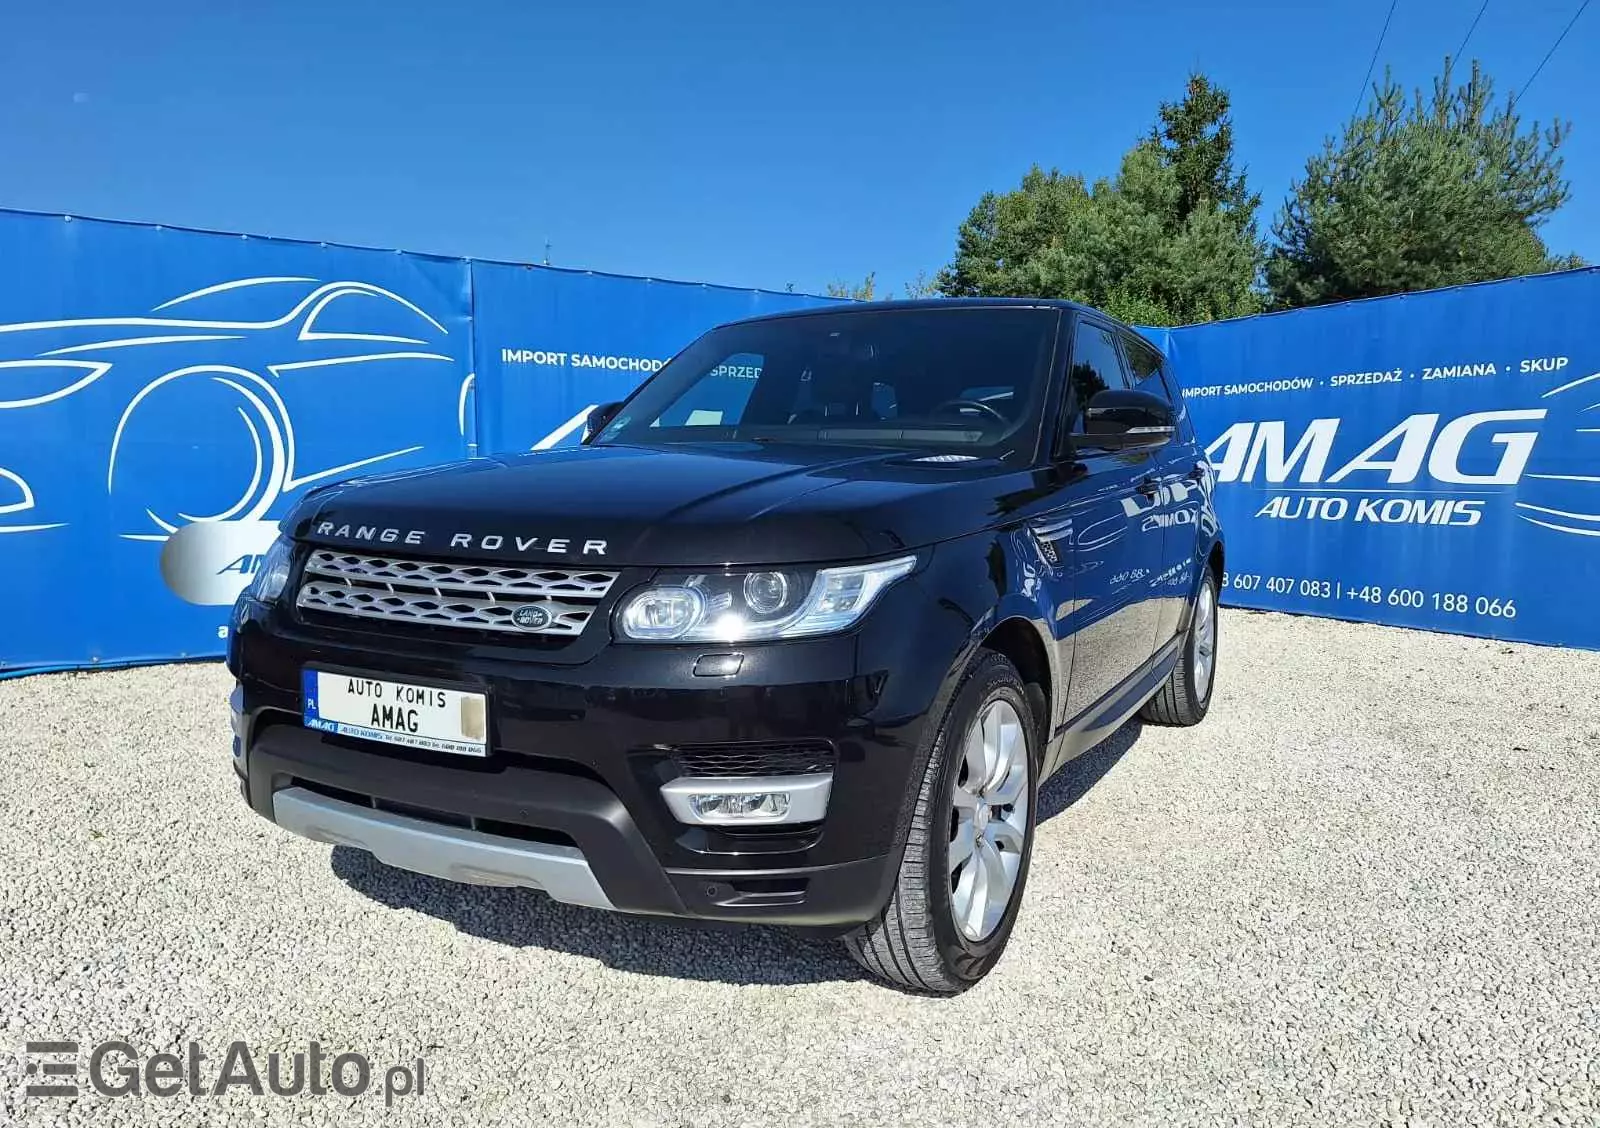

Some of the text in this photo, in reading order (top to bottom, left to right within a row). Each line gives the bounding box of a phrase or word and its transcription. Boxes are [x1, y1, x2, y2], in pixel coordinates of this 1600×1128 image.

[501, 348, 567, 366] IMPORT
[1182, 357, 1568, 398] IMPORT SAMOCHODÓW SPRZEDAŻ ZAMIANA SKUP
[1254, 496, 1485, 526] AUTO KOMIS
[317, 521, 608, 555] RANGE ROVER
[1234, 574, 1261, 590] 607
[1265, 577, 1295, 594] 407
[1300, 580, 1331, 598] 083
[1346, 585, 1382, 604] +48
[1388, 588, 1424, 608] 600
[1432, 592, 1468, 613] 188
[1475, 596, 1517, 618] 066
[347, 679, 447, 708] AUTO KOMIS
[370, 703, 419, 732] AMAG
